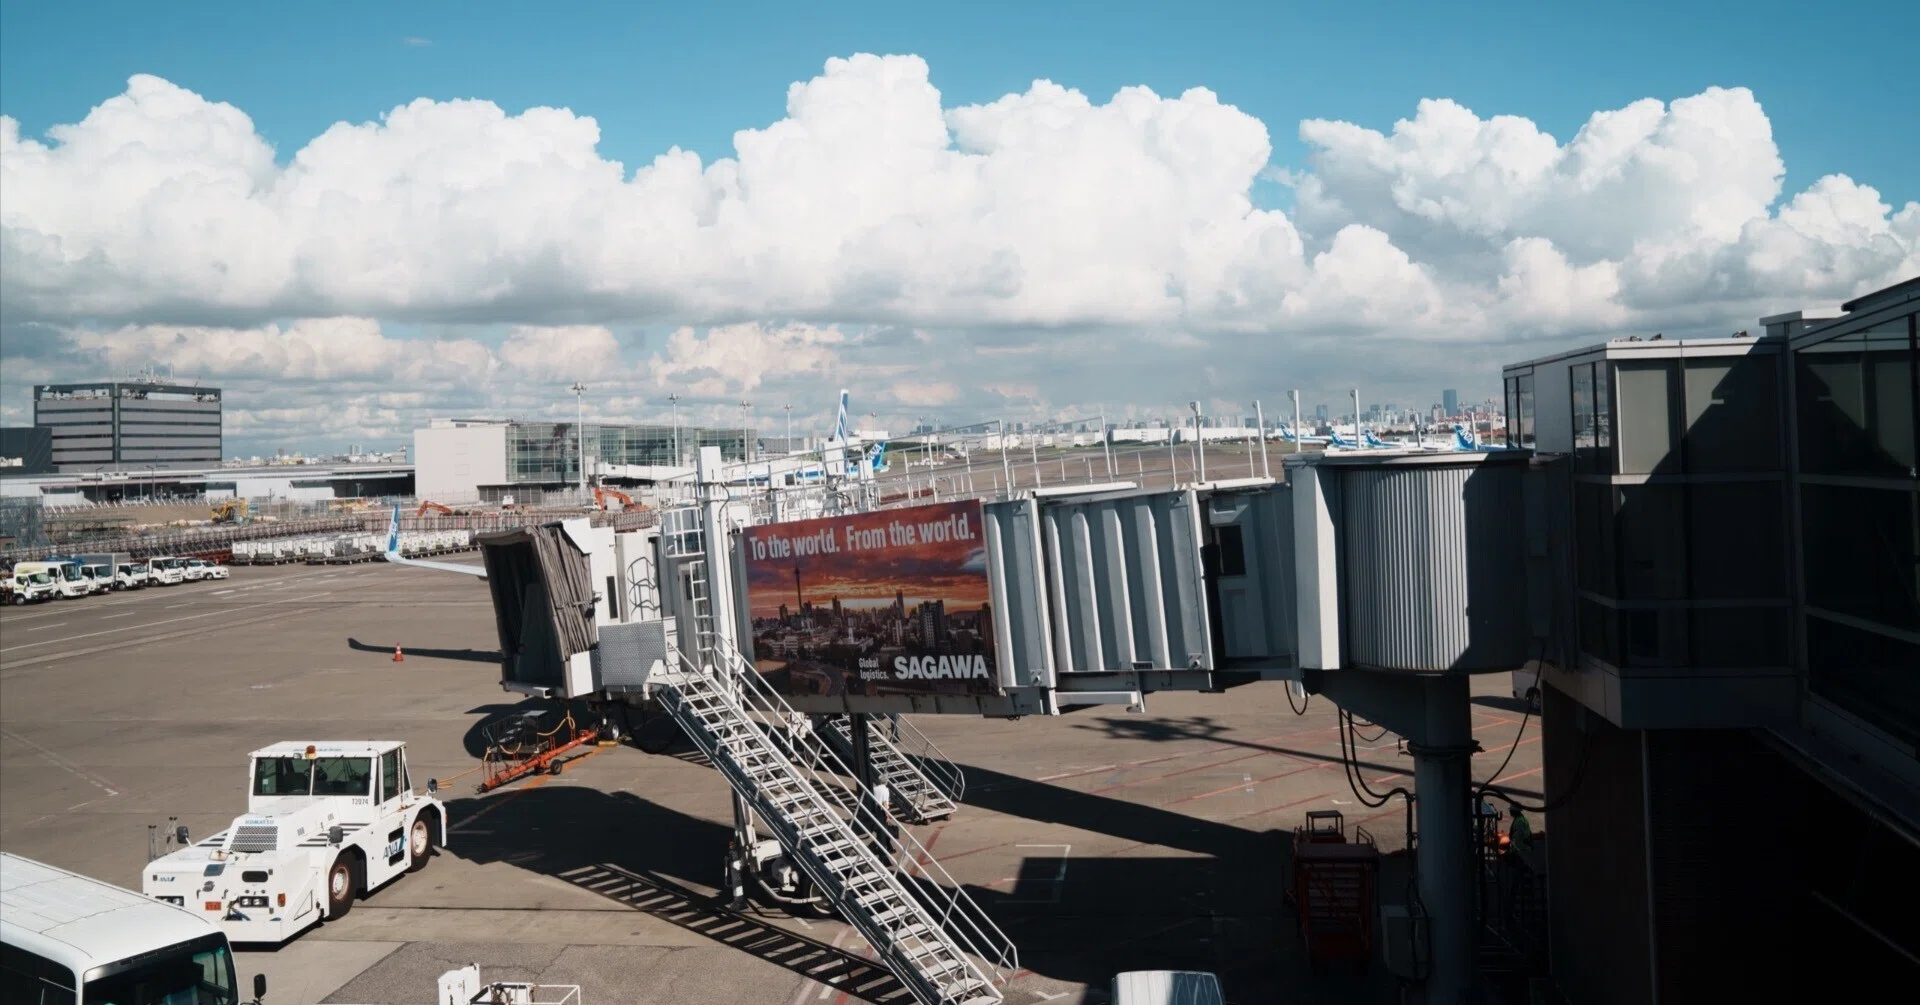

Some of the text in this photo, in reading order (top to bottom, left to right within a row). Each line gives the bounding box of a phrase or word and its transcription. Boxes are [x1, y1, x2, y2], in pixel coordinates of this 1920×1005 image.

[749, 512, 975, 561] To the world. From the world.
[859, 657, 879, 669] Global
[894, 655, 989, 680] SAGAWA
[860, 669, 889, 681] logistics.
[383, 840, 399, 859] ANA
